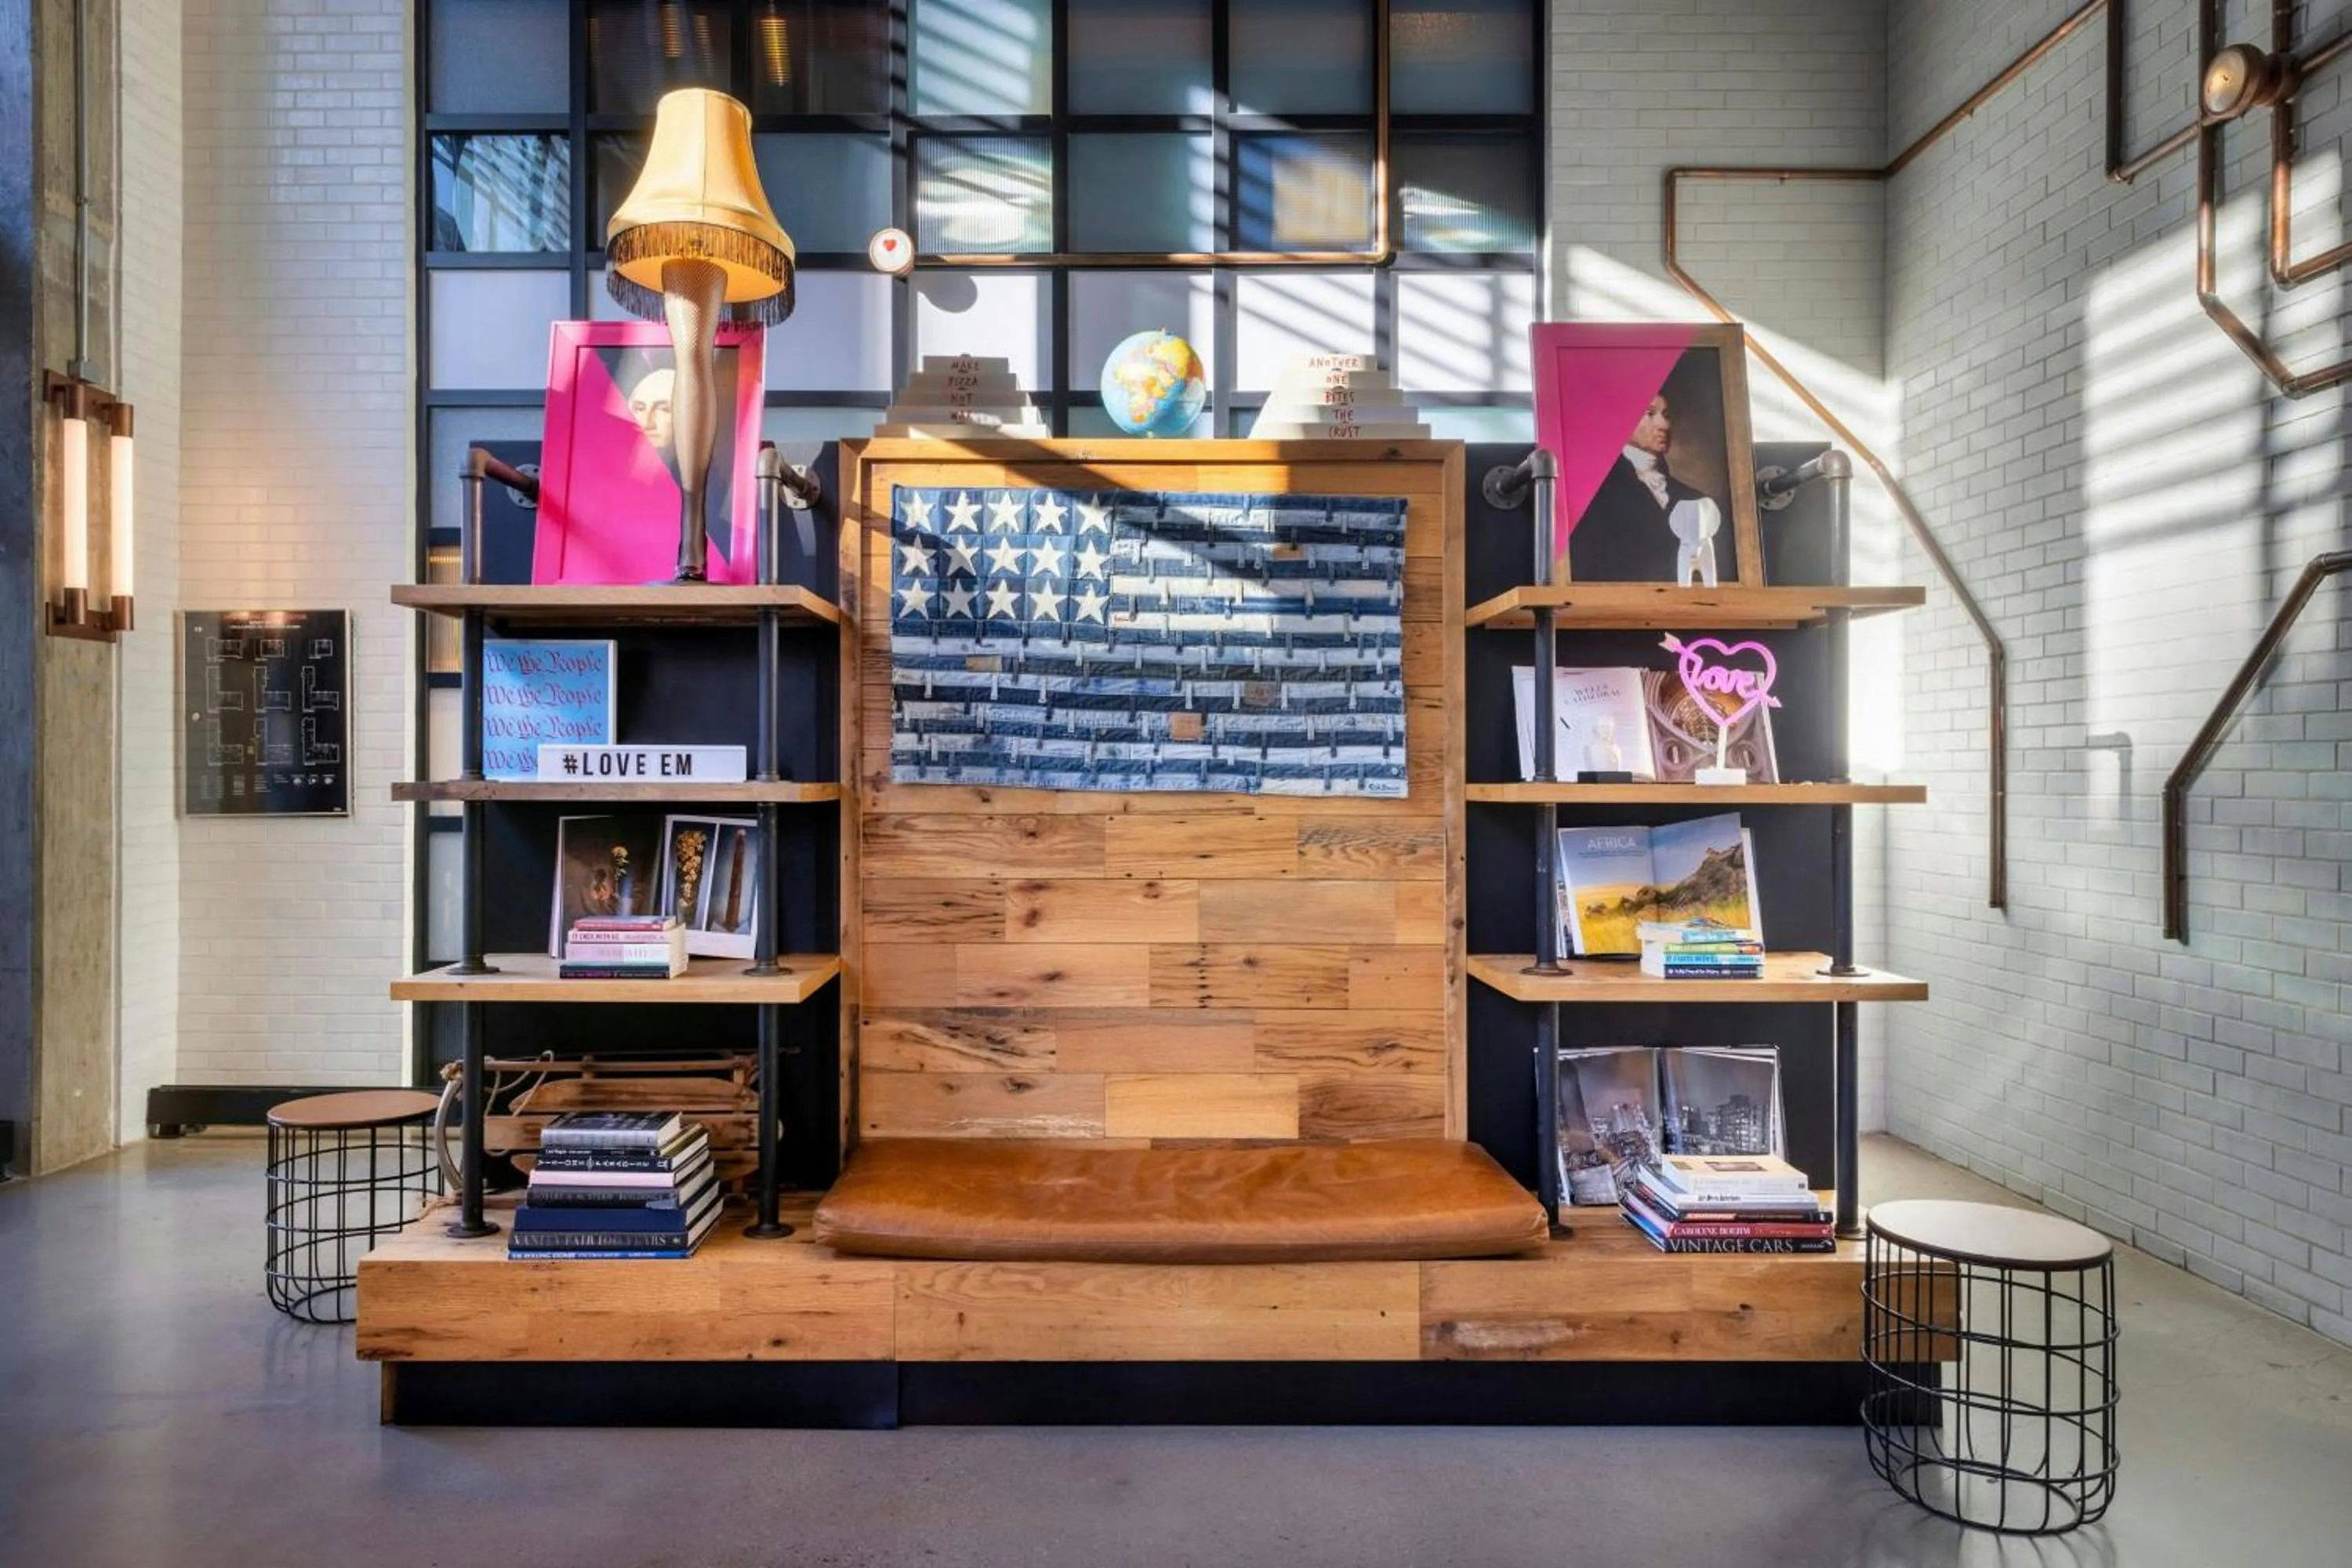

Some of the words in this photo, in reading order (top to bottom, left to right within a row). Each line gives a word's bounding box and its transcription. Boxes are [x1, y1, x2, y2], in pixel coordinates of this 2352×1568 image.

[951, 361, 979, 372] MAKE
[1308, 358, 1358, 368] ANOTHER
[948, 376, 978, 387] PIZZA
[1327, 375, 1348, 385] ONE
[1326, 391, 1355, 404] BITES
[1333, 408, 1354, 421] THE
[1329, 426, 1361, 438] CRUST
[486, 652, 514, 672] We
[517, 651, 542, 675] the
[544, 650, 601, 677] People
[485, 684, 514, 705] We
[517, 683, 542, 707] the
[544, 682, 602, 709] People
[485, 716, 514, 737] We
[517, 715, 541, 739] the
[544, 715, 602, 741] People
[485, 749, 515, 770] We
[563, 753, 646, 775] #LOVE
[661, 753, 692, 775] EM
[1587, 837, 1636, 849] AFRICA
[564, 1234, 594, 1246] FAIR
[1669, 1238, 1744, 1252] VINTAGE
[1749, 1238, 1793, 1252] CARS
